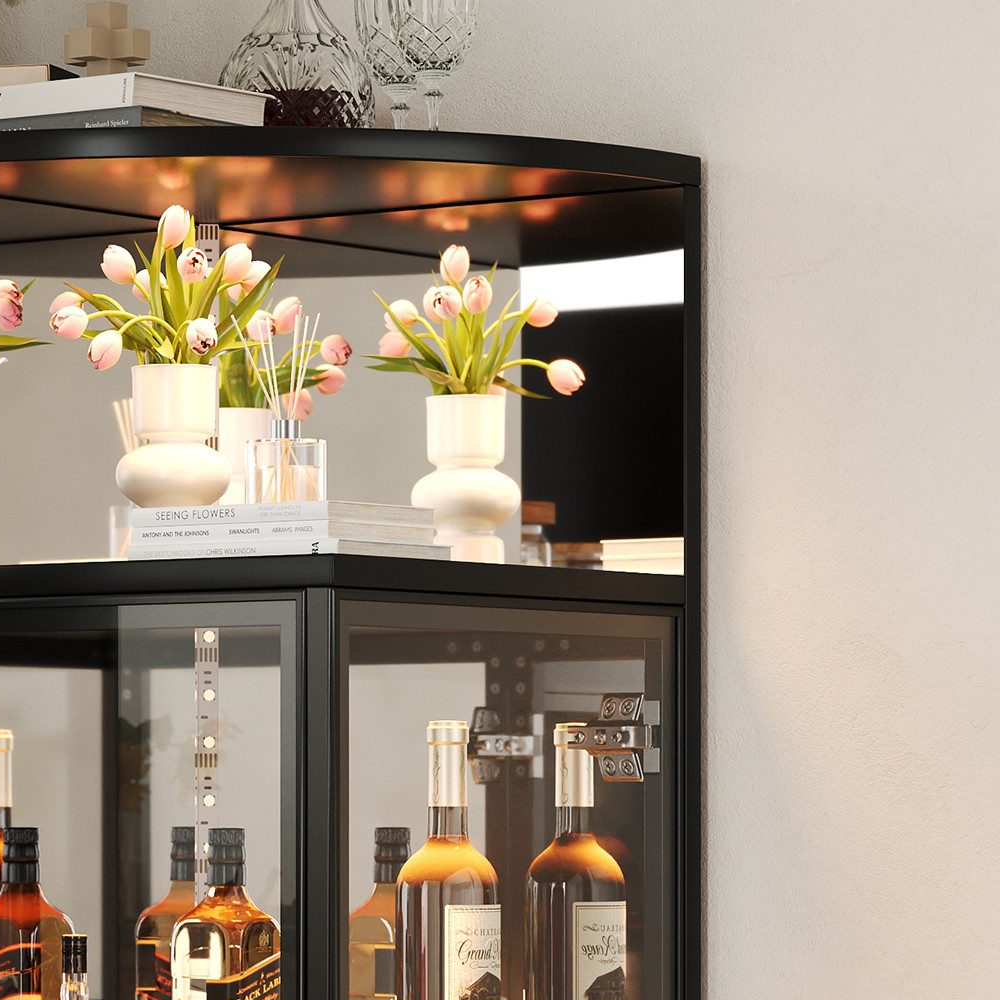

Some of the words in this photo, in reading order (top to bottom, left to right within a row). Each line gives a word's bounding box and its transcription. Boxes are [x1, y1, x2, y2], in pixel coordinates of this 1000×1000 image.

[85, 120, 110, 128] Reinhard
[110, 119, 130, 128] Spieler
[155, 510, 189, 521] SEEING
[192, 508, 236, 519] FLOWERS
[184, 529, 210, 537] JOHNSONS
[205, 548, 222, 556] CHRIS
[224, 546, 257, 555] WILKINSON
[457, 938, 495, 966] Grand
